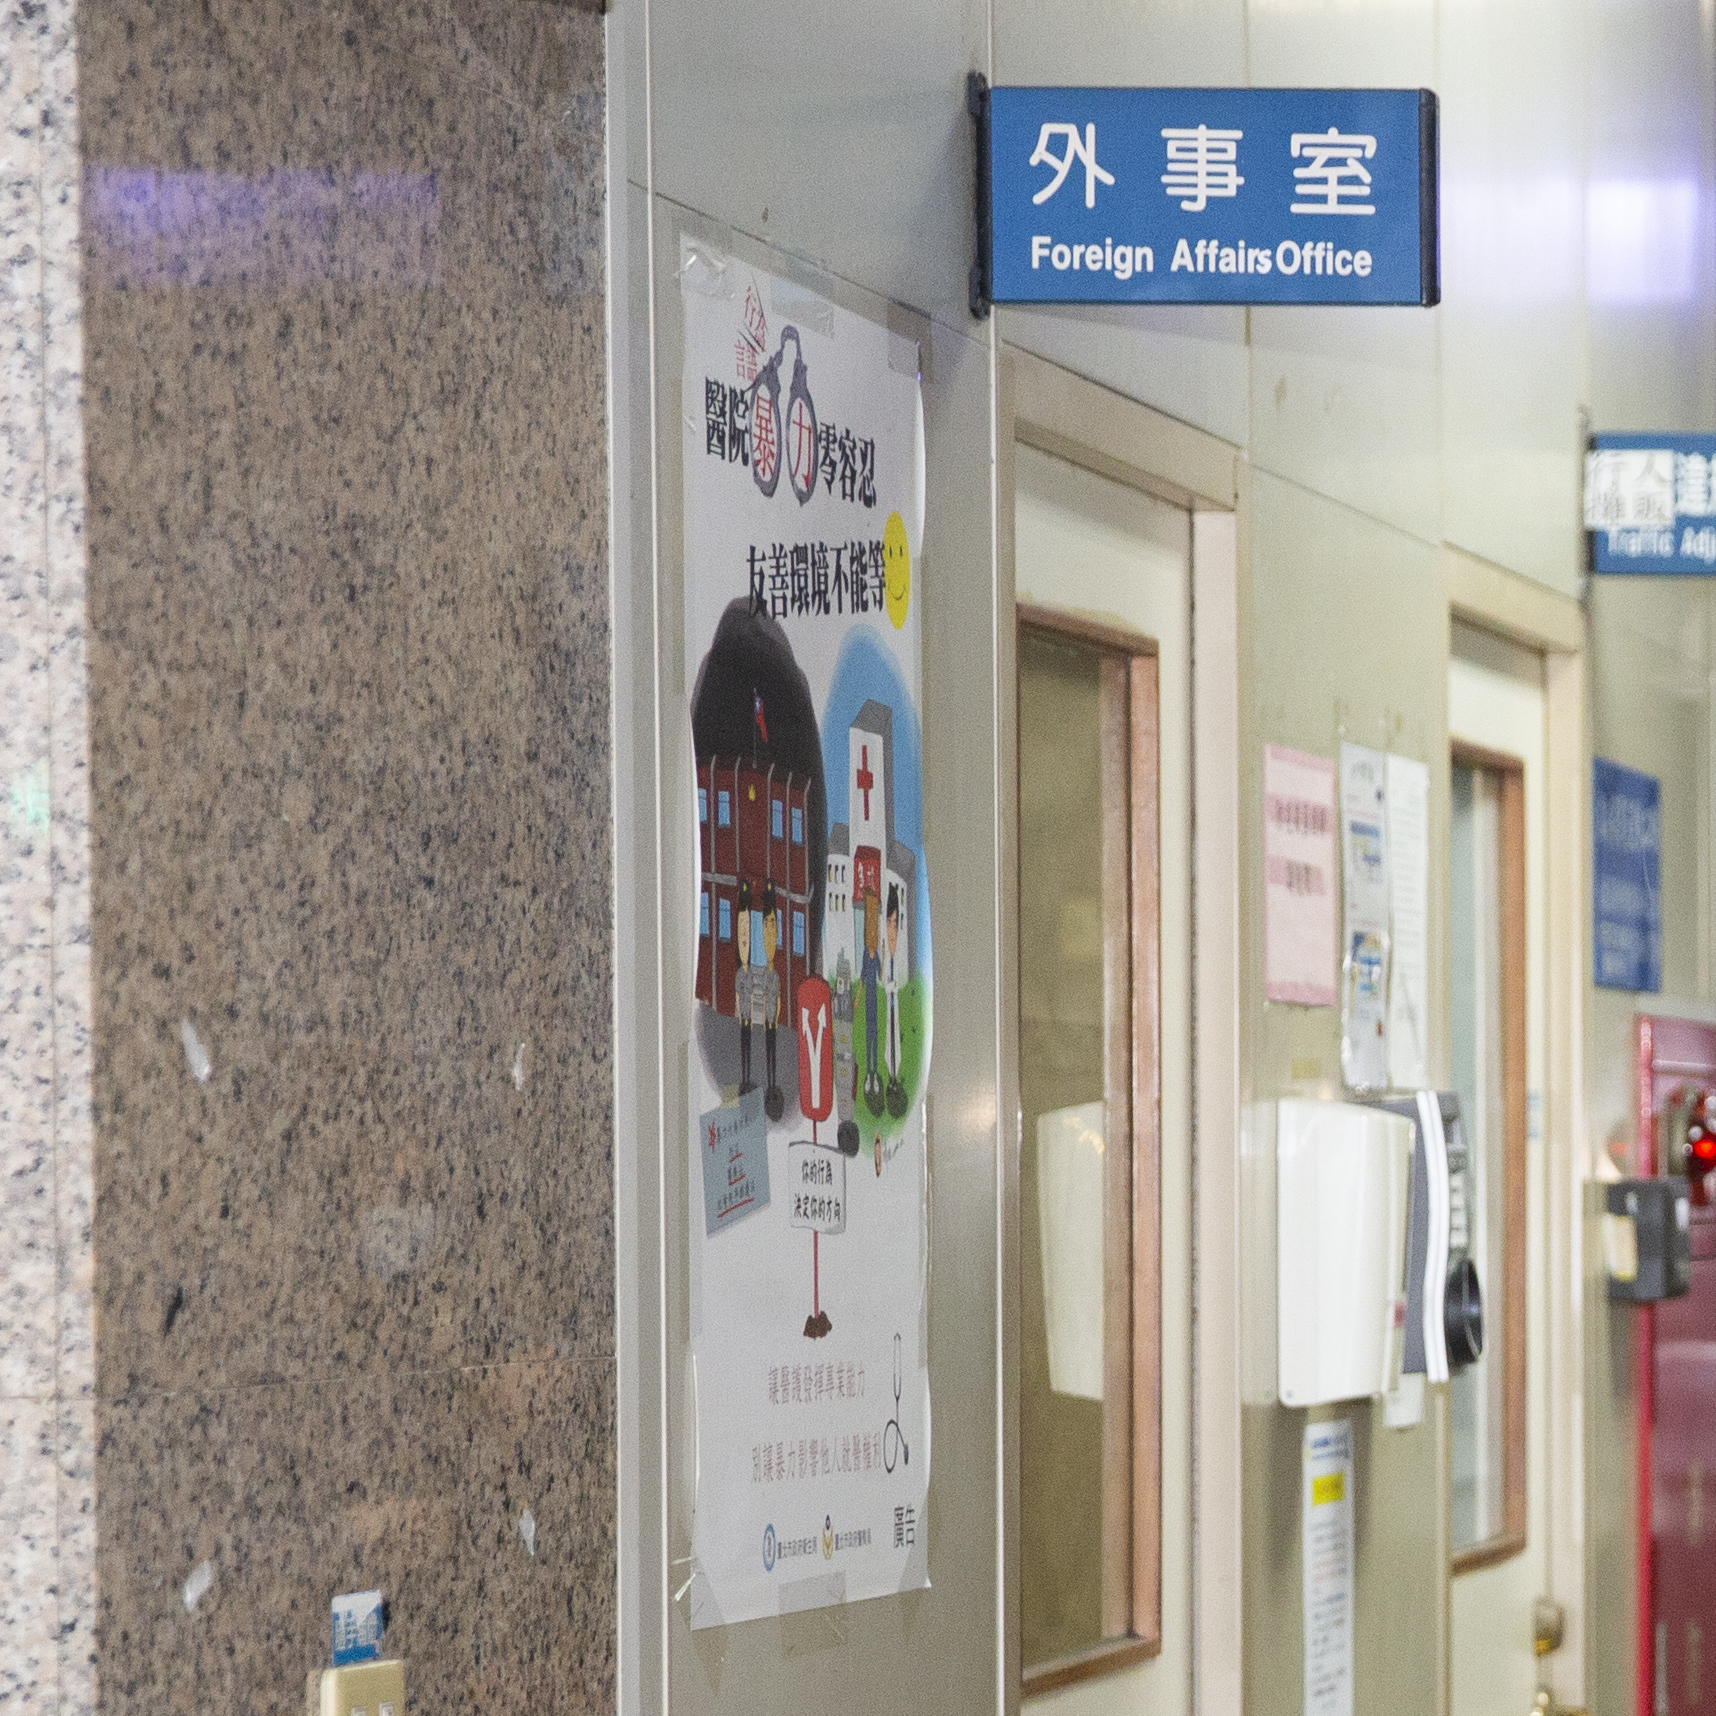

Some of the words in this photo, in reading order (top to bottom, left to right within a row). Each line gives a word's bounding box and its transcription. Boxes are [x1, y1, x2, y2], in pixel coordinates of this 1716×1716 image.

[1028, 121, 1377, 216] 外事室
[1030, 236, 1154, 280] Foreign
[1170, 238, 1273, 275] Affairs
[1275, 240, 1373, 276] Office
[746, 540, 886, 619] 友善環境不能等
